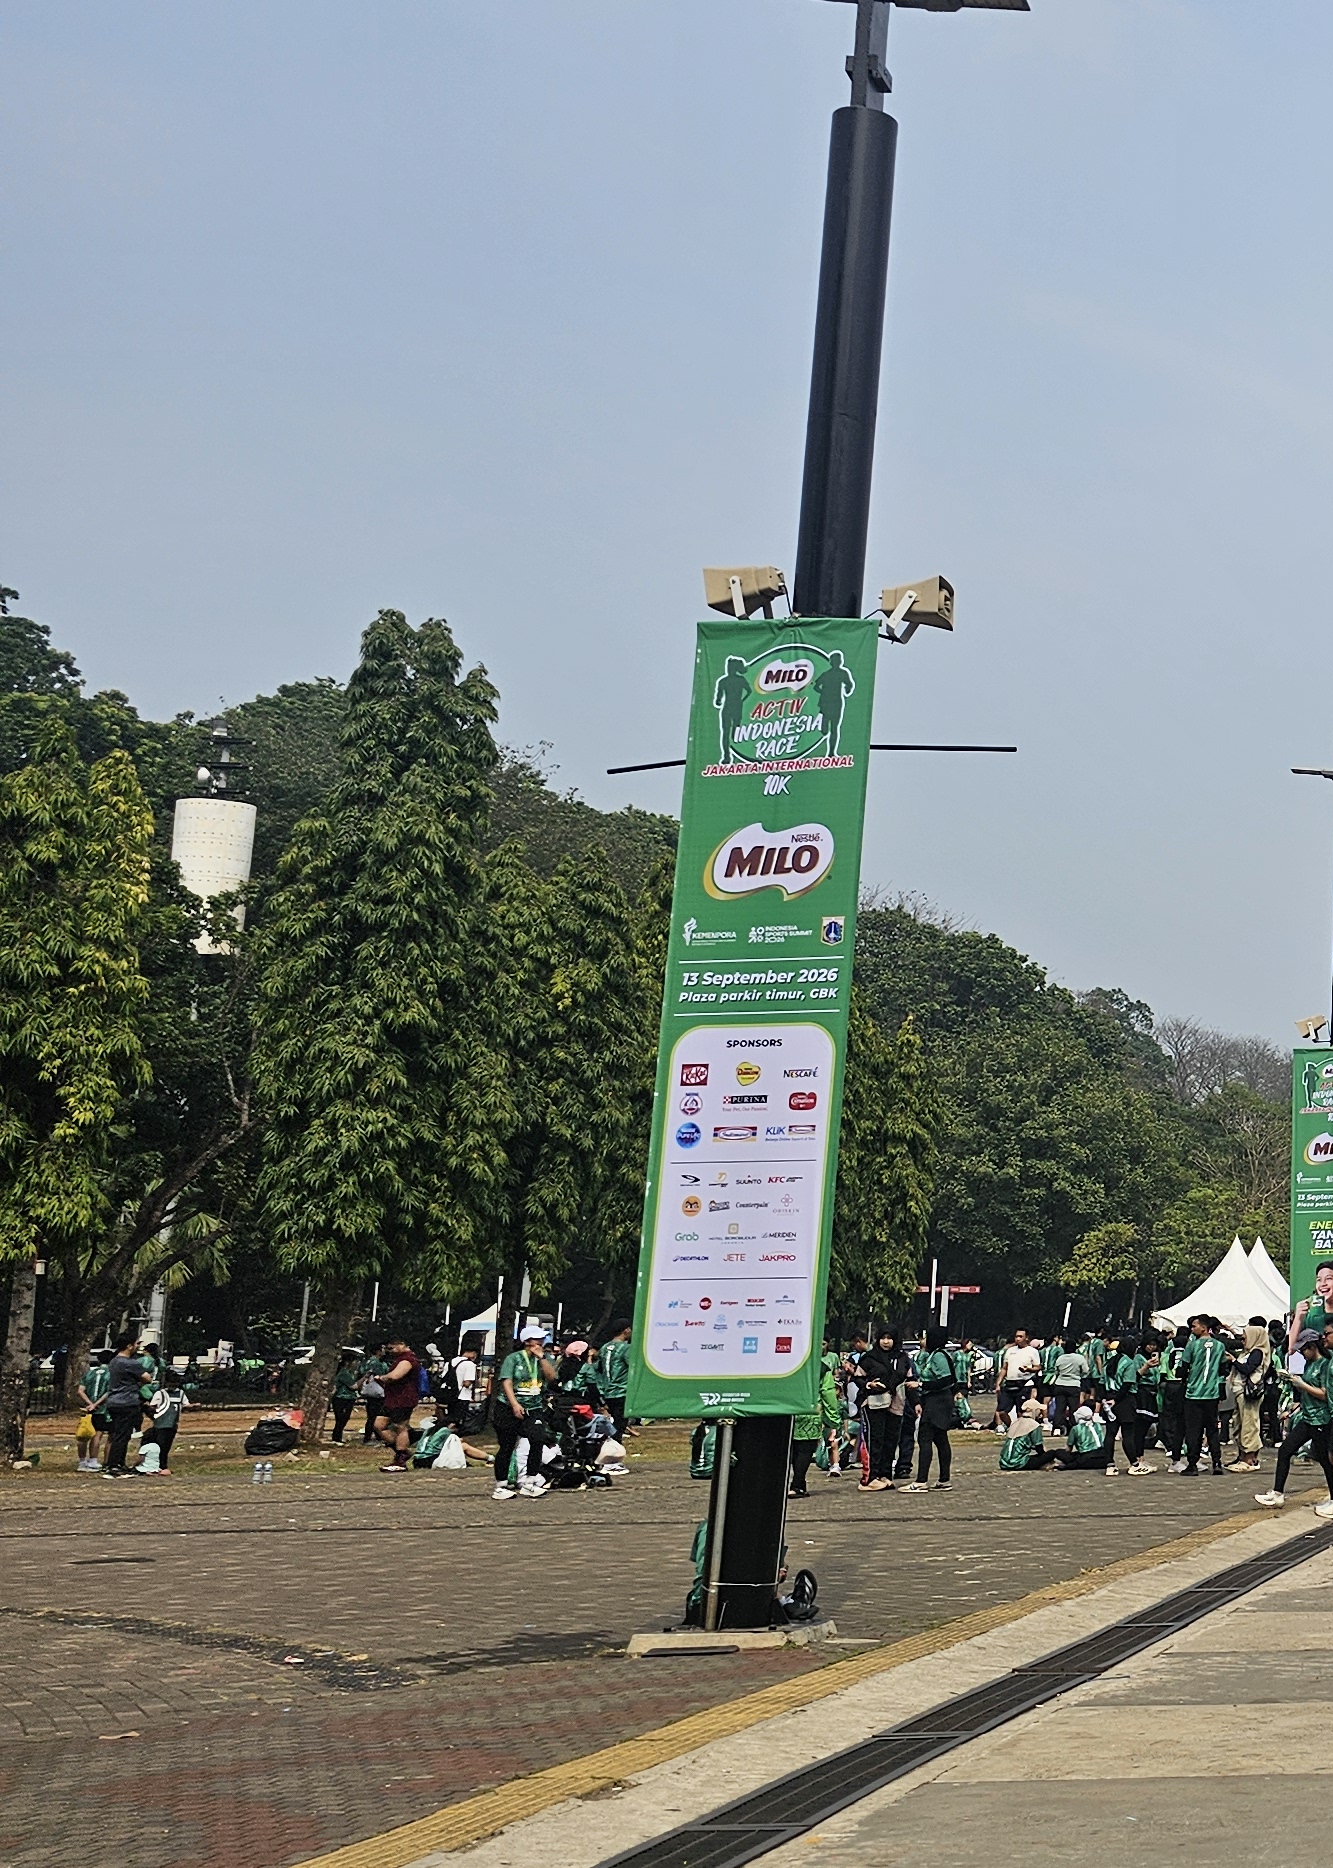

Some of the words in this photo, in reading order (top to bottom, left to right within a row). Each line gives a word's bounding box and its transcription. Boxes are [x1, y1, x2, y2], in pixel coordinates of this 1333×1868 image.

[764, 668, 808, 684] MILO
[750, 697, 809, 720] ACTIV
[734, 713, 824, 743] INDONESIA
[755, 737, 801, 760] RACE
[702, 762, 759, 777] JAKARTA
[760, 755, 855, 772] INTERNATIONAL
[763, 774, 791, 795] 10K
[724, 845, 820, 878] MILO
[682, 972, 699, 986] 13
[702, 971, 794, 988] September
[797, 968, 838, 983] 2026
[679, 992, 716, 1003] Plaza
[720, 990, 762, 1004] parkir
[765, 989, 805, 1001] timur,
[810, 988, 838, 999] GBK
[726, 1039, 783, 1048] SPONSORS
[732, 1096, 768, 1104] PURINA
[759, 1254, 796, 1262] JAKPRO
